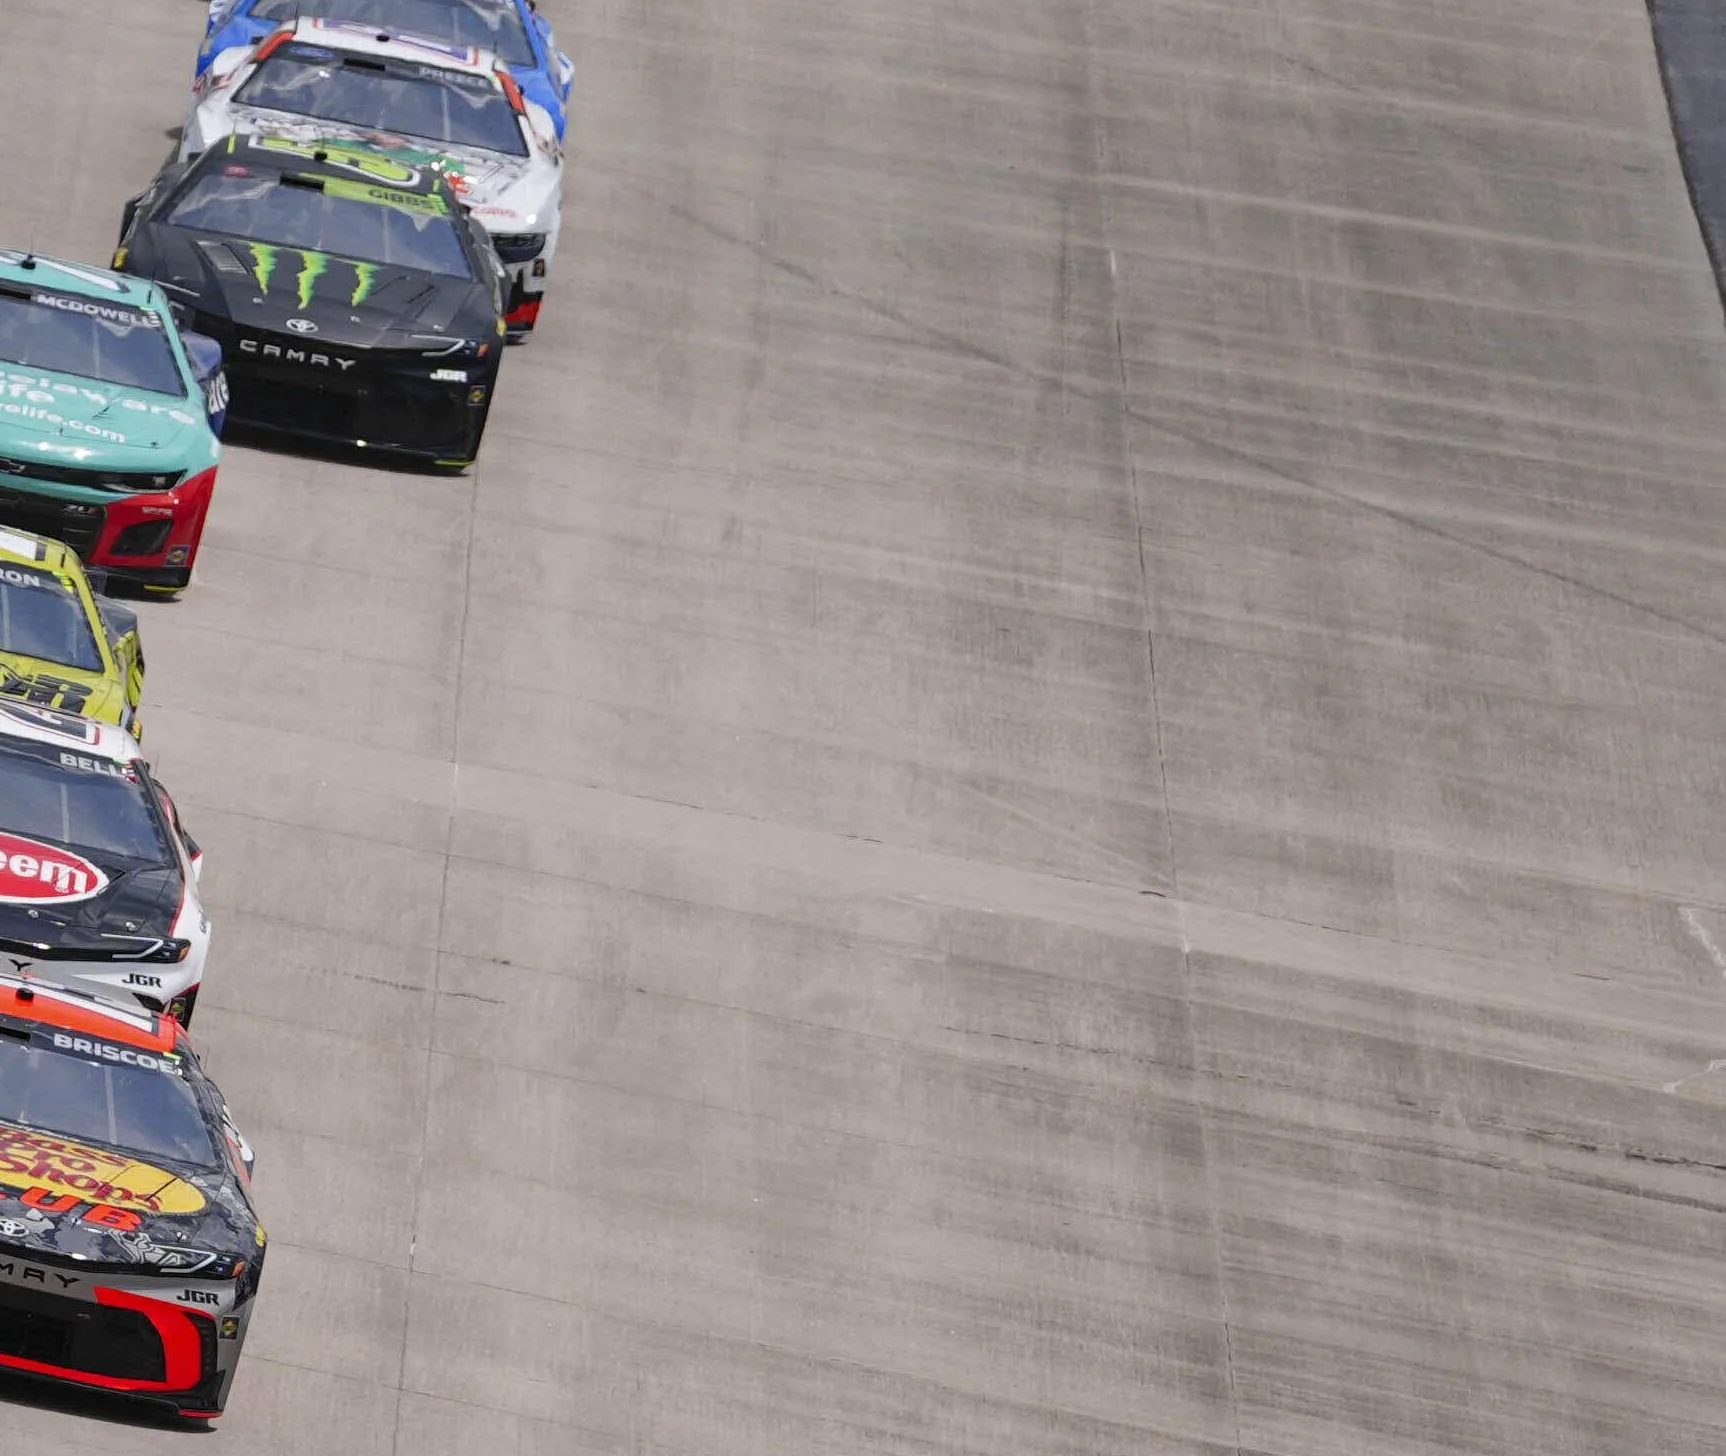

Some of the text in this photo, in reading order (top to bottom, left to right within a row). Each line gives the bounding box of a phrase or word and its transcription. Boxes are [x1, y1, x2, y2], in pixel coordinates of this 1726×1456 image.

[368, 188, 441, 212] GIBBS
[239, 339, 357, 371] CAMRY
[60, 752, 124, 777] BELL
[121, 972, 163, 989] JGR
[53, 1032, 180, 1076] BRISCOE
[176, 1289, 220, 1306] JGR
